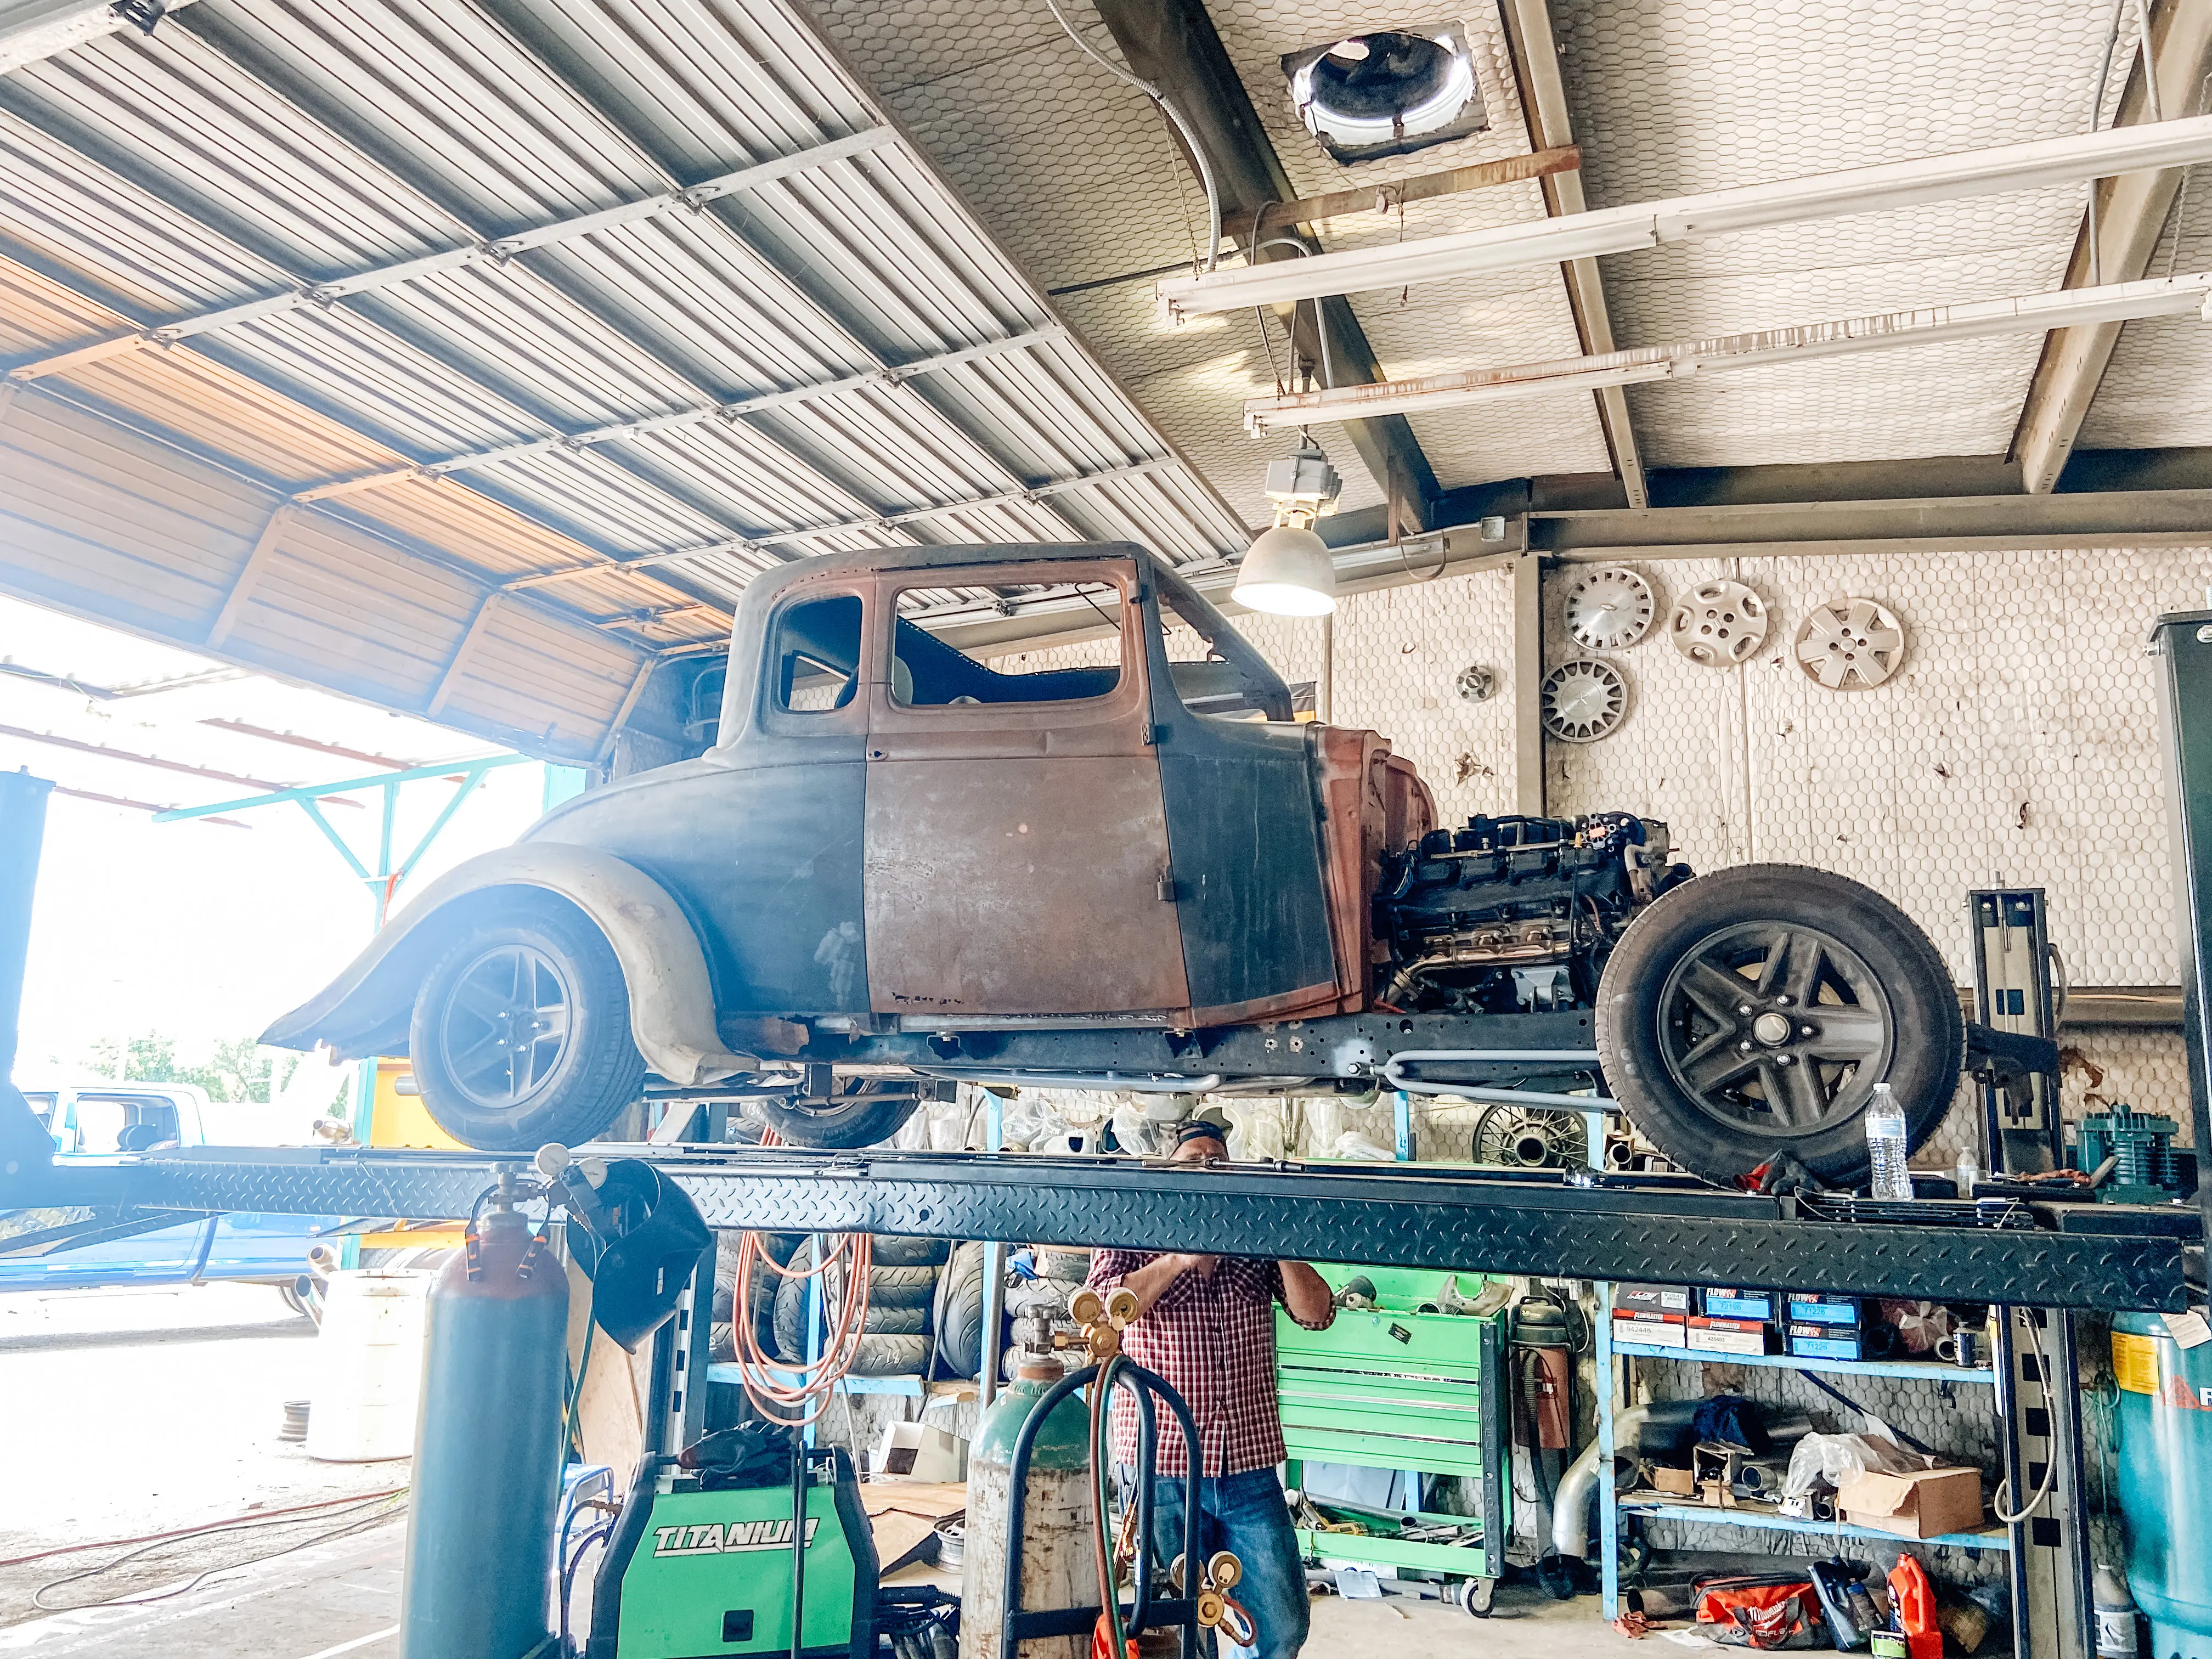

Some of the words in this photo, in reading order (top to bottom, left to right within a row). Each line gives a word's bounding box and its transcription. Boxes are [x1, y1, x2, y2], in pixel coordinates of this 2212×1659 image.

[1626, 1325, 1652, 1334] 942448
[1709, 1321, 1741, 1329] FLOWMASTER
[653, 1517, 820, 1554] TITANIUM
